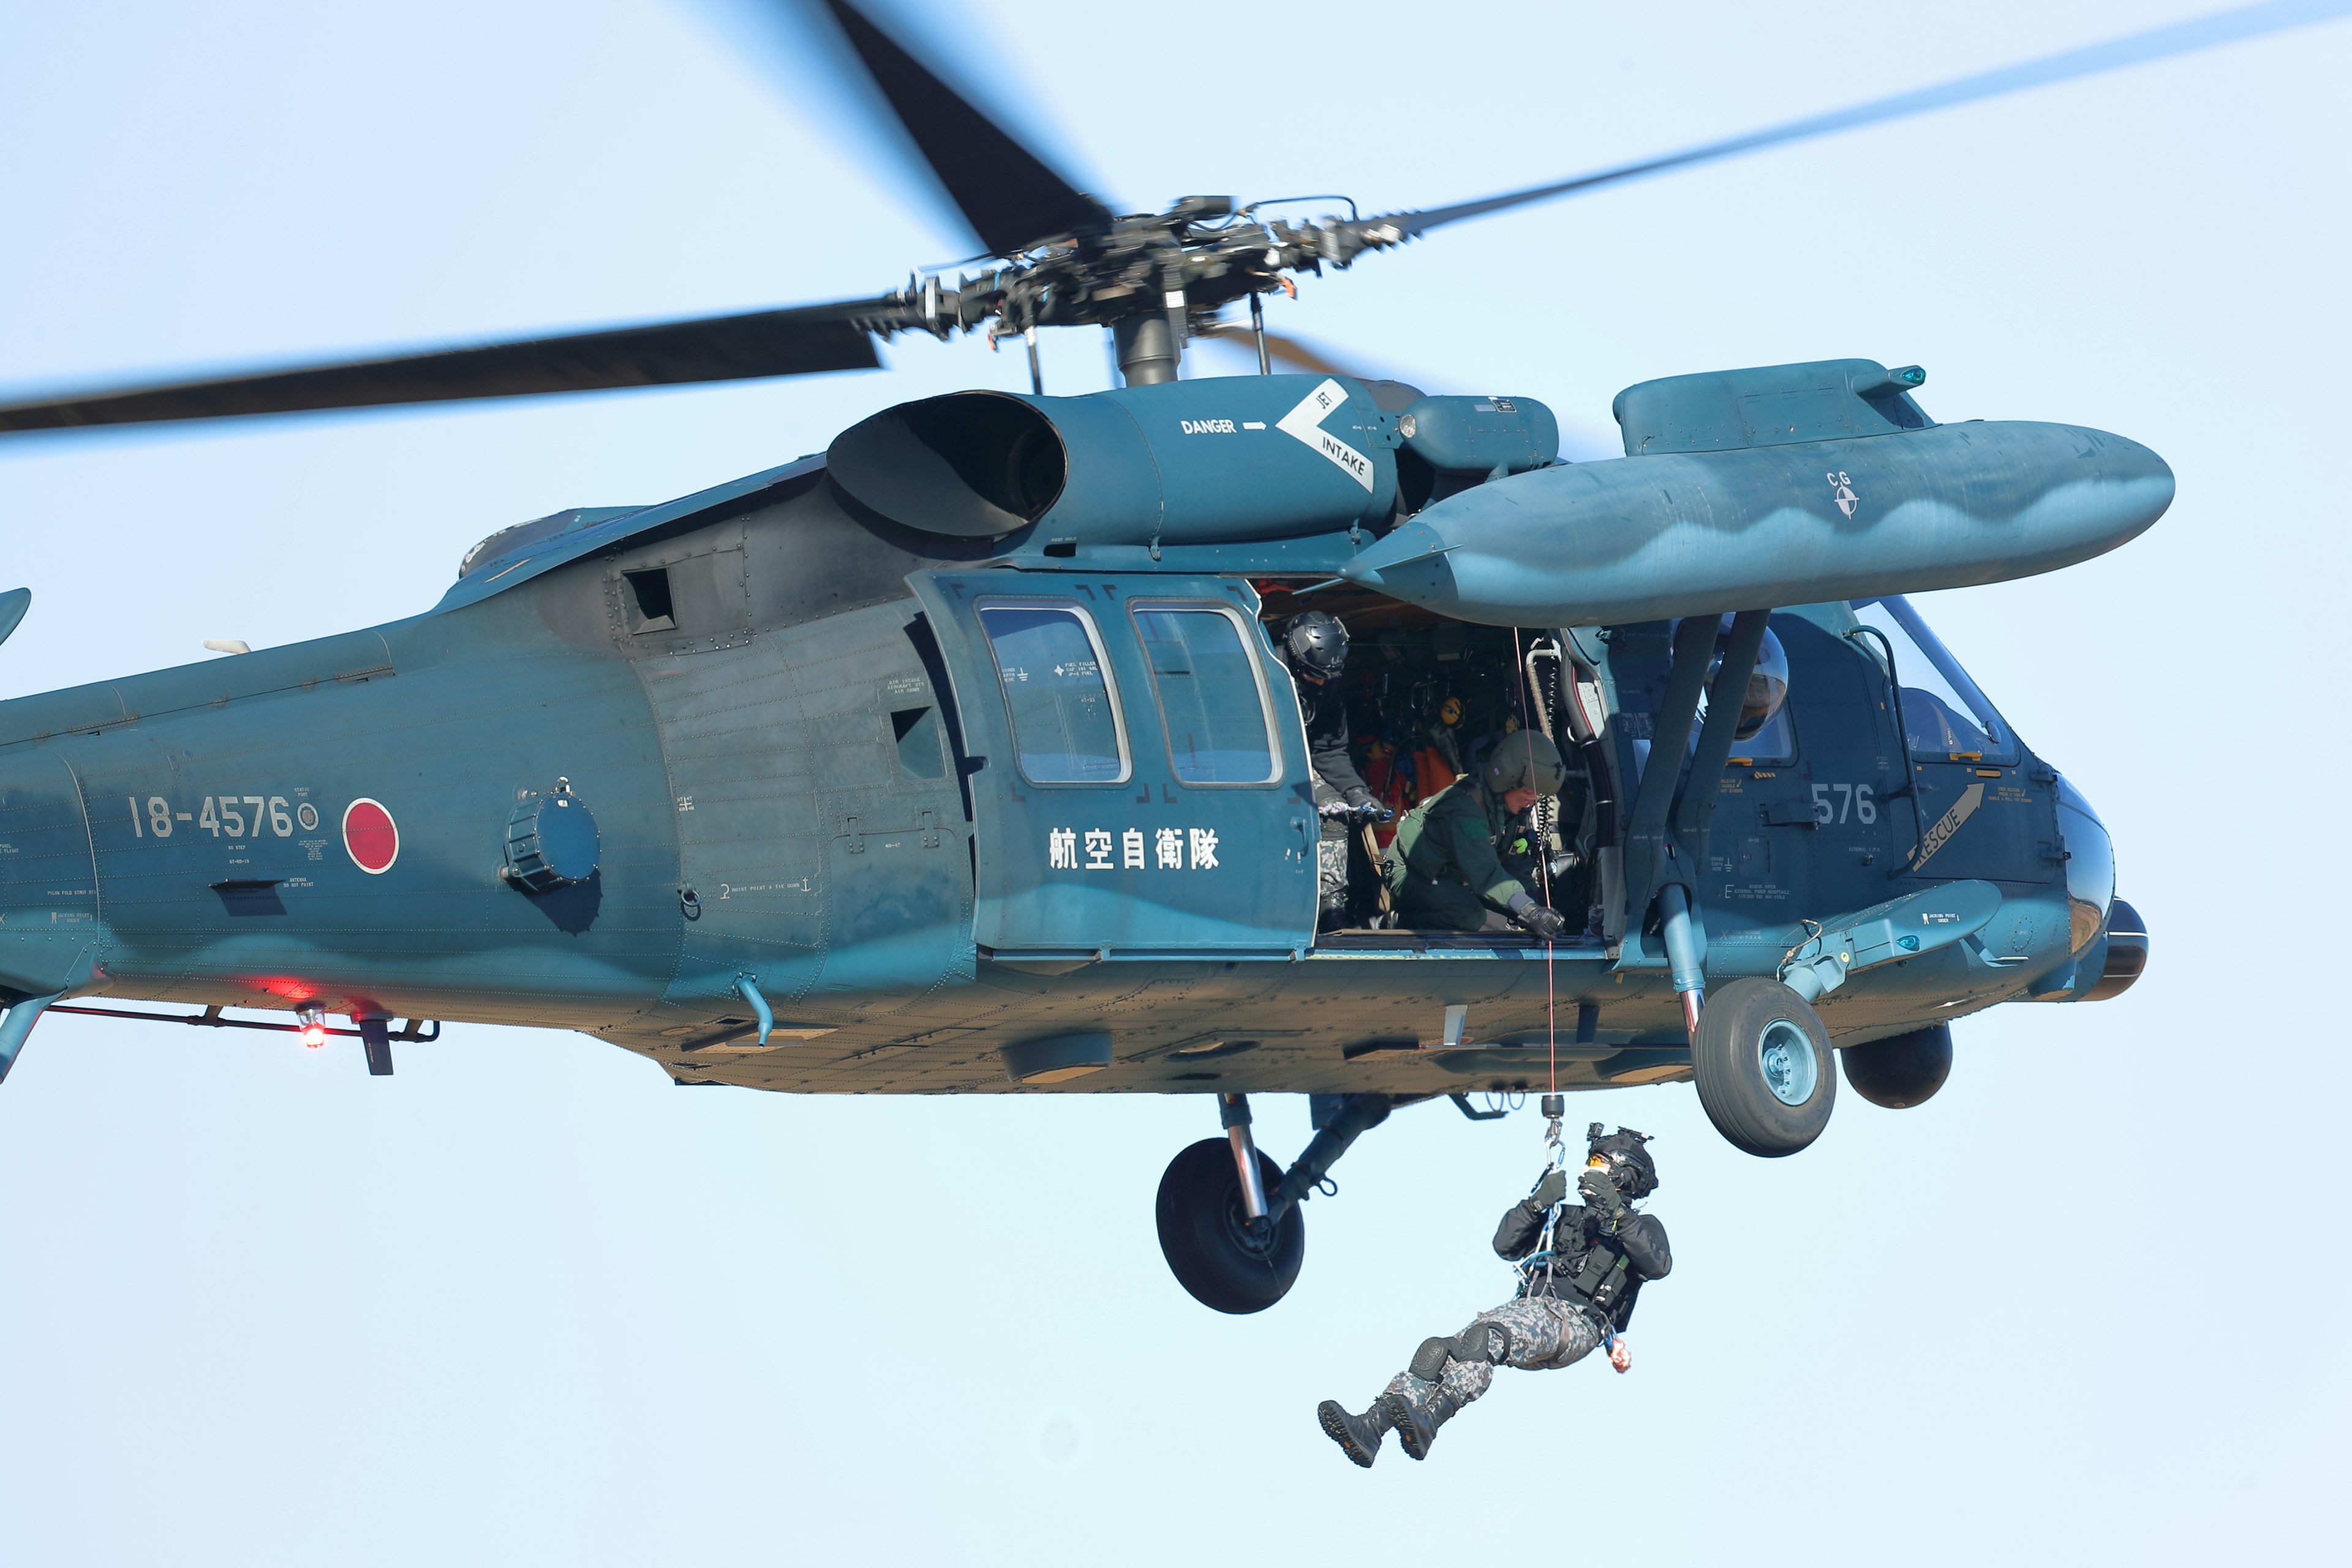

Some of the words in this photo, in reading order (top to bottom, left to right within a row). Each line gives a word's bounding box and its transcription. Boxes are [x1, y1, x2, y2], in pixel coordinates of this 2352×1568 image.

[1316, 391, 1332, 409] JET
[1180, 419, 1237, 434] DANGER
[1322, 436, 1365, 476] INTAKE
[129, 796, 293, 837] 18-4576
[1811, 784, 1877, 824] 576
[1049, 827, 1219, 870] 航空自衛隊
